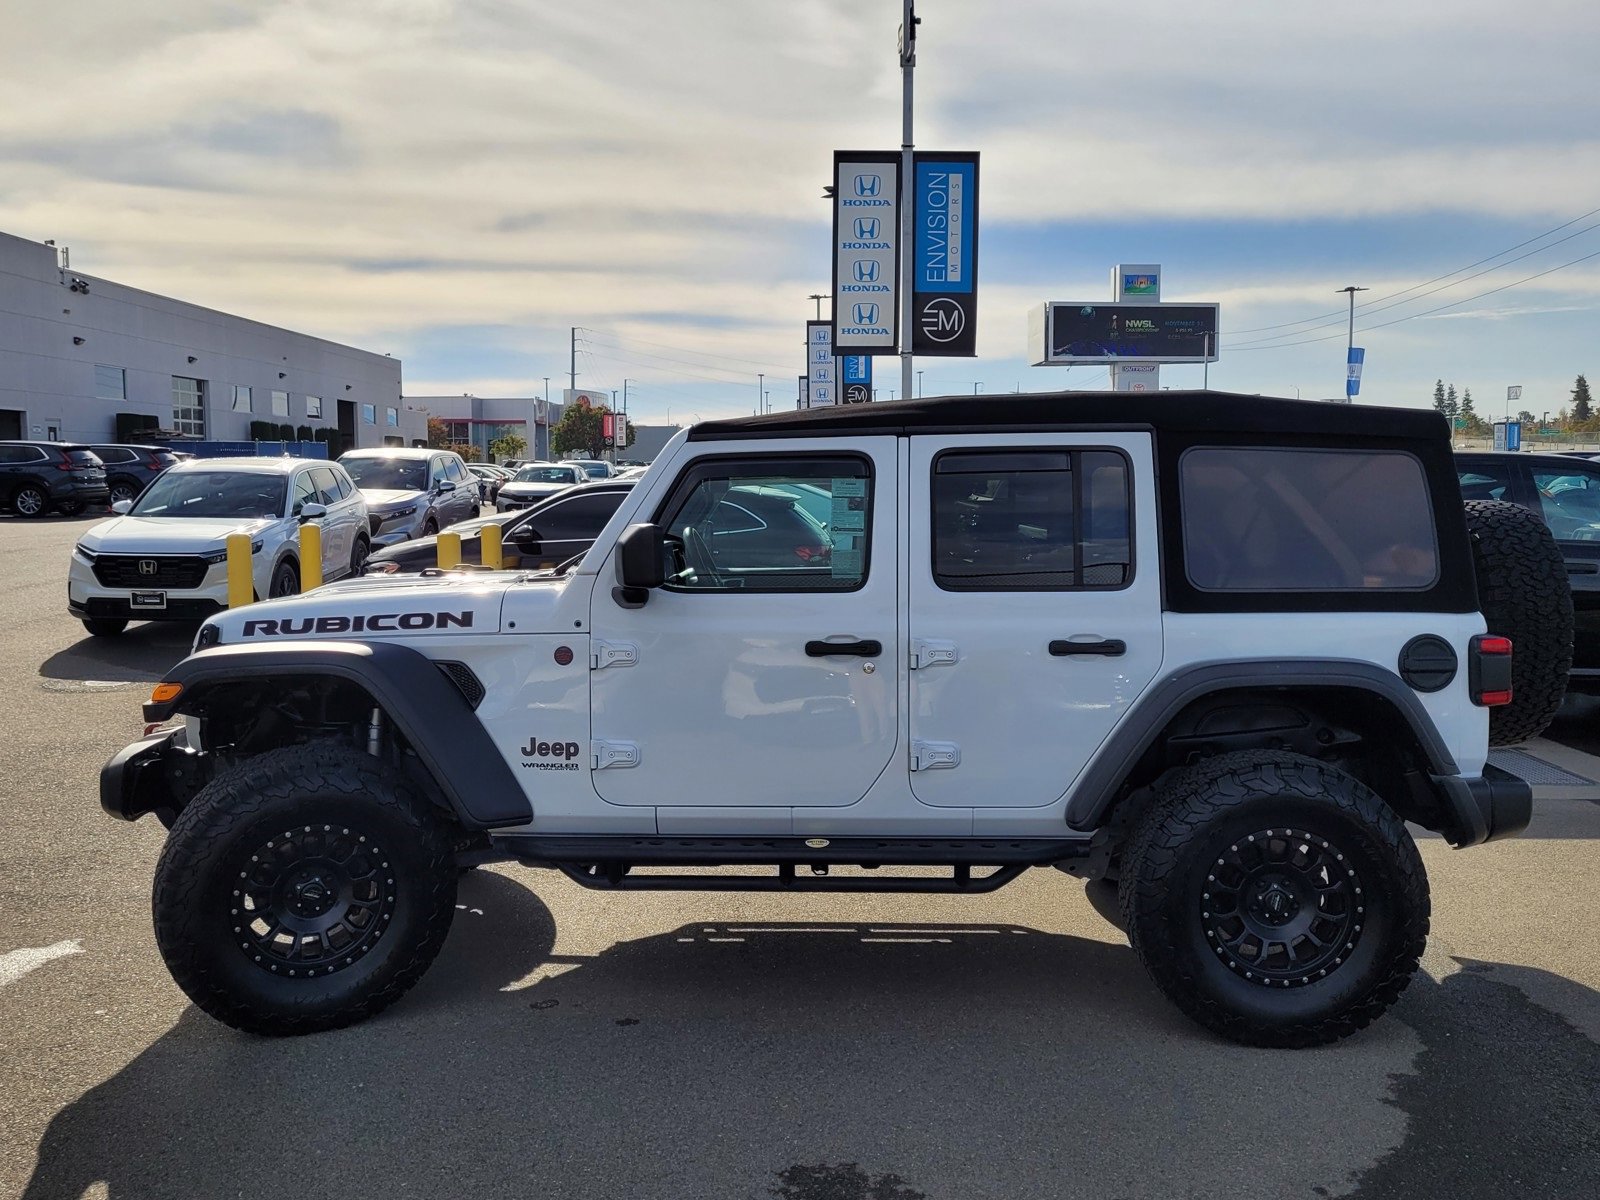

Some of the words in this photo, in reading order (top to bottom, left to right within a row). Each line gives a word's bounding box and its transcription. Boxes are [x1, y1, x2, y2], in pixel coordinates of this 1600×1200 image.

[842, 199, 892, 207] HONDA
[926, 173, 947, 282] ENVISION
[950, 183, 960, 273] MOTORS
[1125, 320, 1155, 328] NWSL
[242, 611, 474, 637] RUBICON
[521, 737, 580, 760] Jeep
